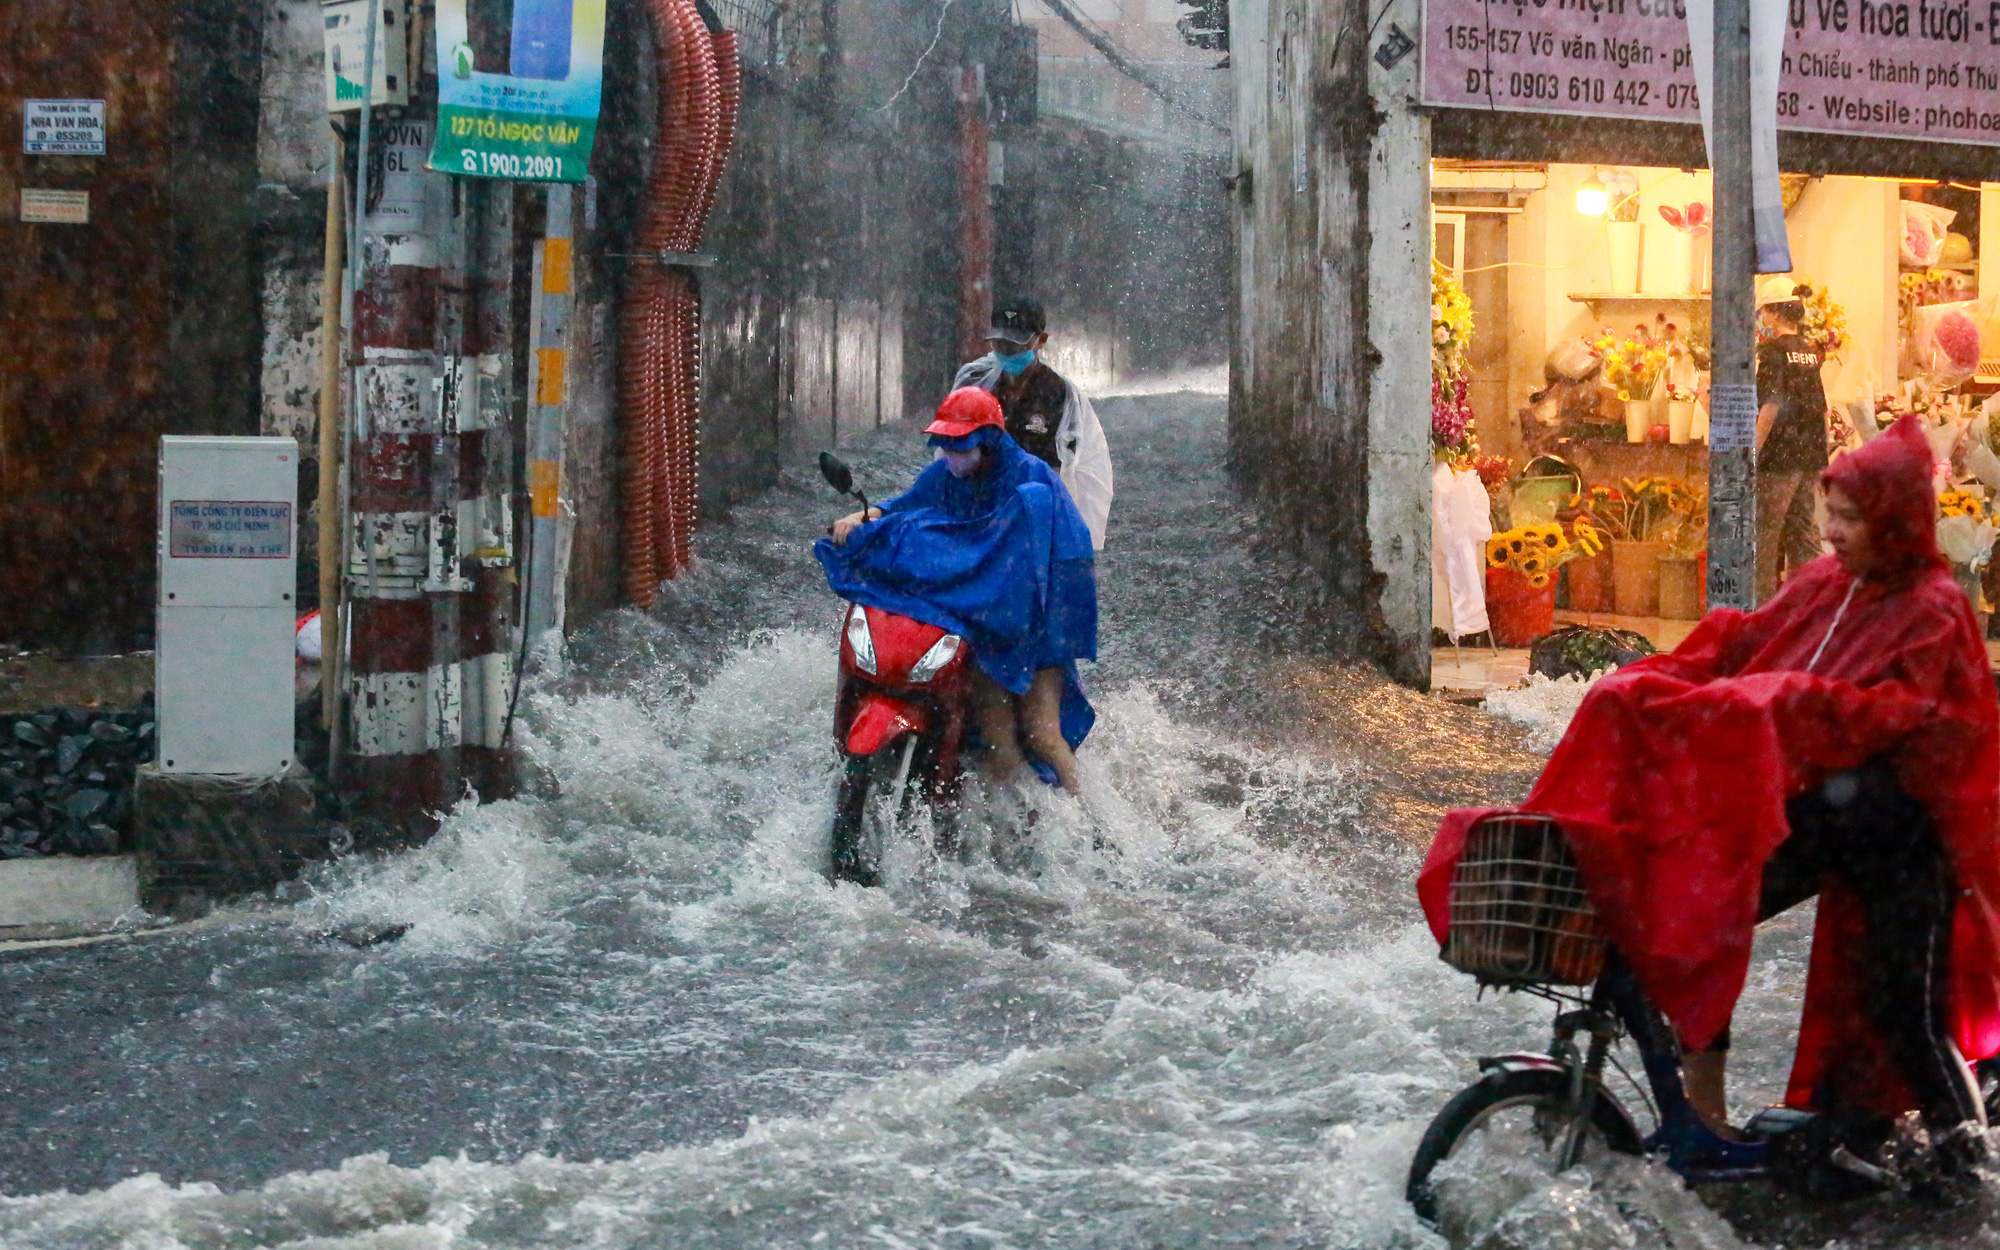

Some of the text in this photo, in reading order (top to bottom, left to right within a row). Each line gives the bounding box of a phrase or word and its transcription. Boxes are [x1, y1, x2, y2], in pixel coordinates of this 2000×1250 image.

[1860, 0, 1909, 37] hoa
[1919, 0, 1969, 43] tươi
[1445, 25, 1522, 54] 155-157
[1528, 31, 1554, 57] Võ
[1561, 34, 1596, 60] văn
[1603, 37, 1654, 69] Ngân
[1799, 49, 1852, 79] Chiểu
[1868, 58, 1920, 84] thành
[1926, 61, 1961, 91] phố
[1965, 64, 1998, 90] Thủ
[1509, 71, 1560, 100] 0903
[1568, 76, 1605, 103] 610
[1613, 79, 1650, 106] 442
[37, 131, 47, 140] ID
[451, 116, 474, 136] 127
[499, 120, 545, 147] NGỌC
[547, 121, 580, 144] VÂN
[480, 151, 563, 179] 1900.2091
[232, 507, 241, 516] TY
[244, 521, 270, 531] MINH
